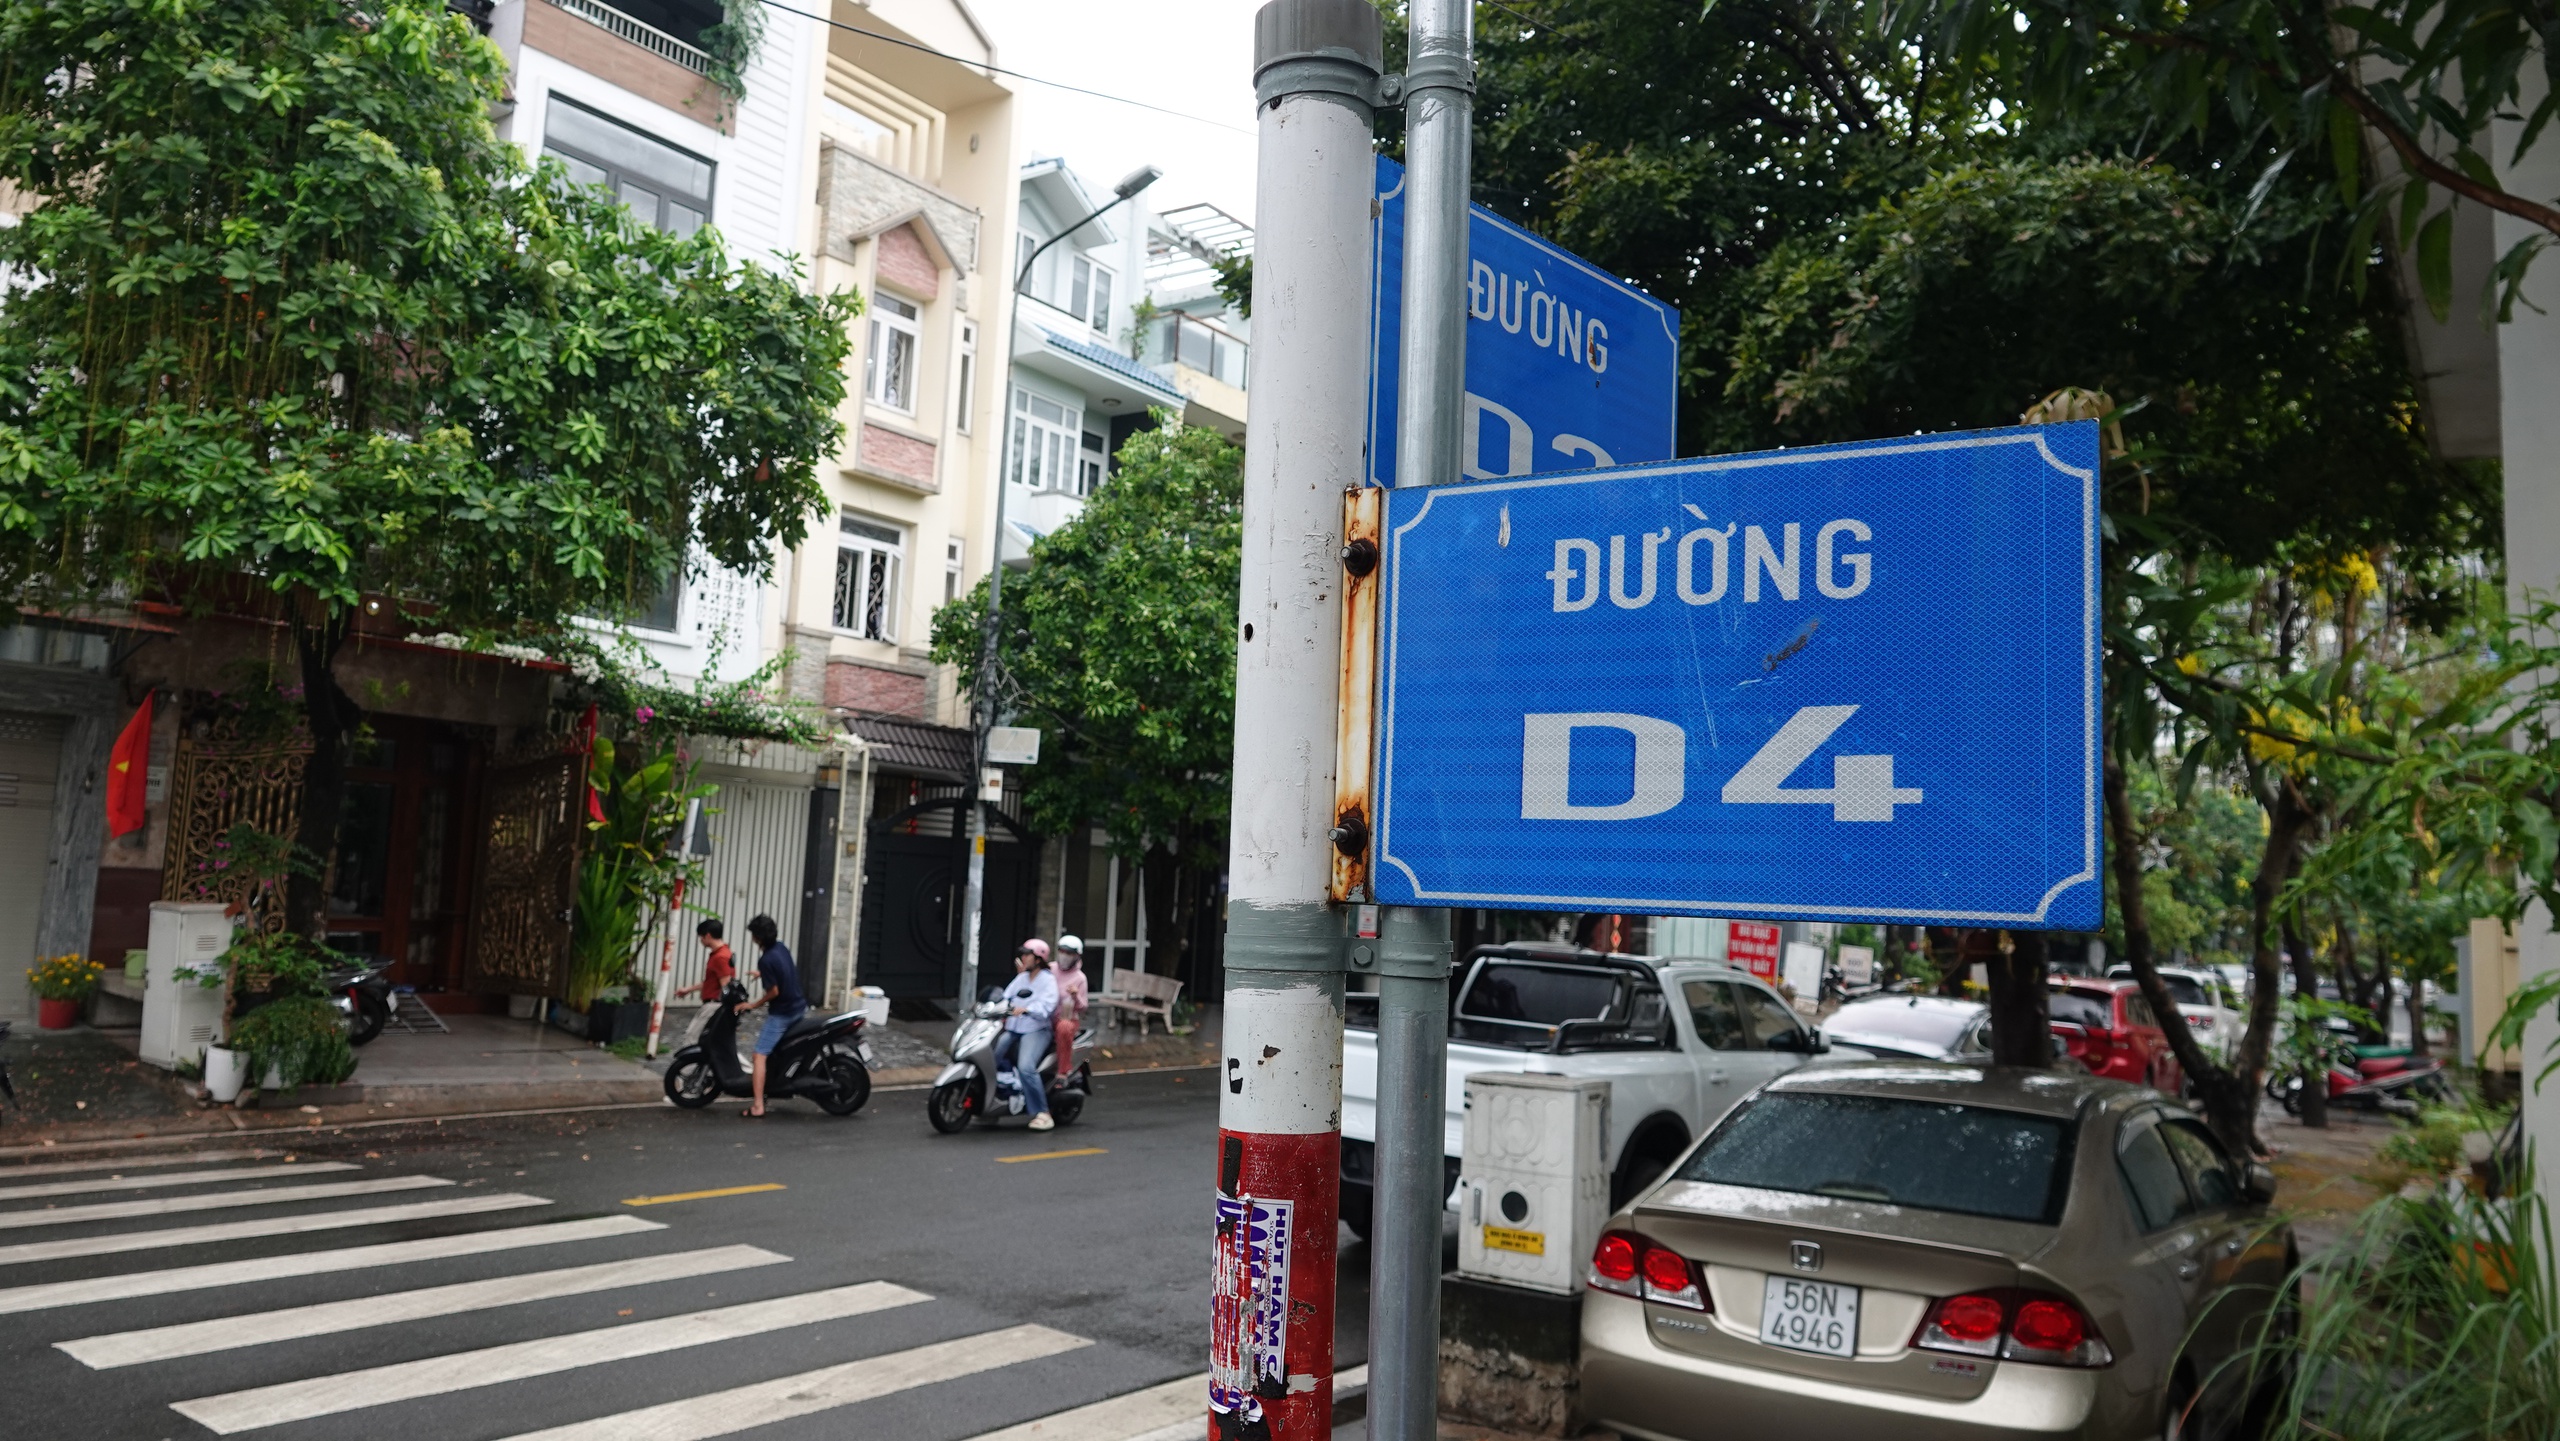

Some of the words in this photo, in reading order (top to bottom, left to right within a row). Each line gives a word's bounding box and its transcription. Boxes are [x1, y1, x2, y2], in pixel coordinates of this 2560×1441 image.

[1468, 259, 1609, 374] ĐƯỜNG
[1546, 503, 1873, 613] ĐƯỜNG
[1521, 704, 1924, 822] D4
[1273, 1208, 1288, 1268] HÚT
[1771, 1312, 1844, 1350] 4946
[1784, 1281, 1838, 1318] 56N
